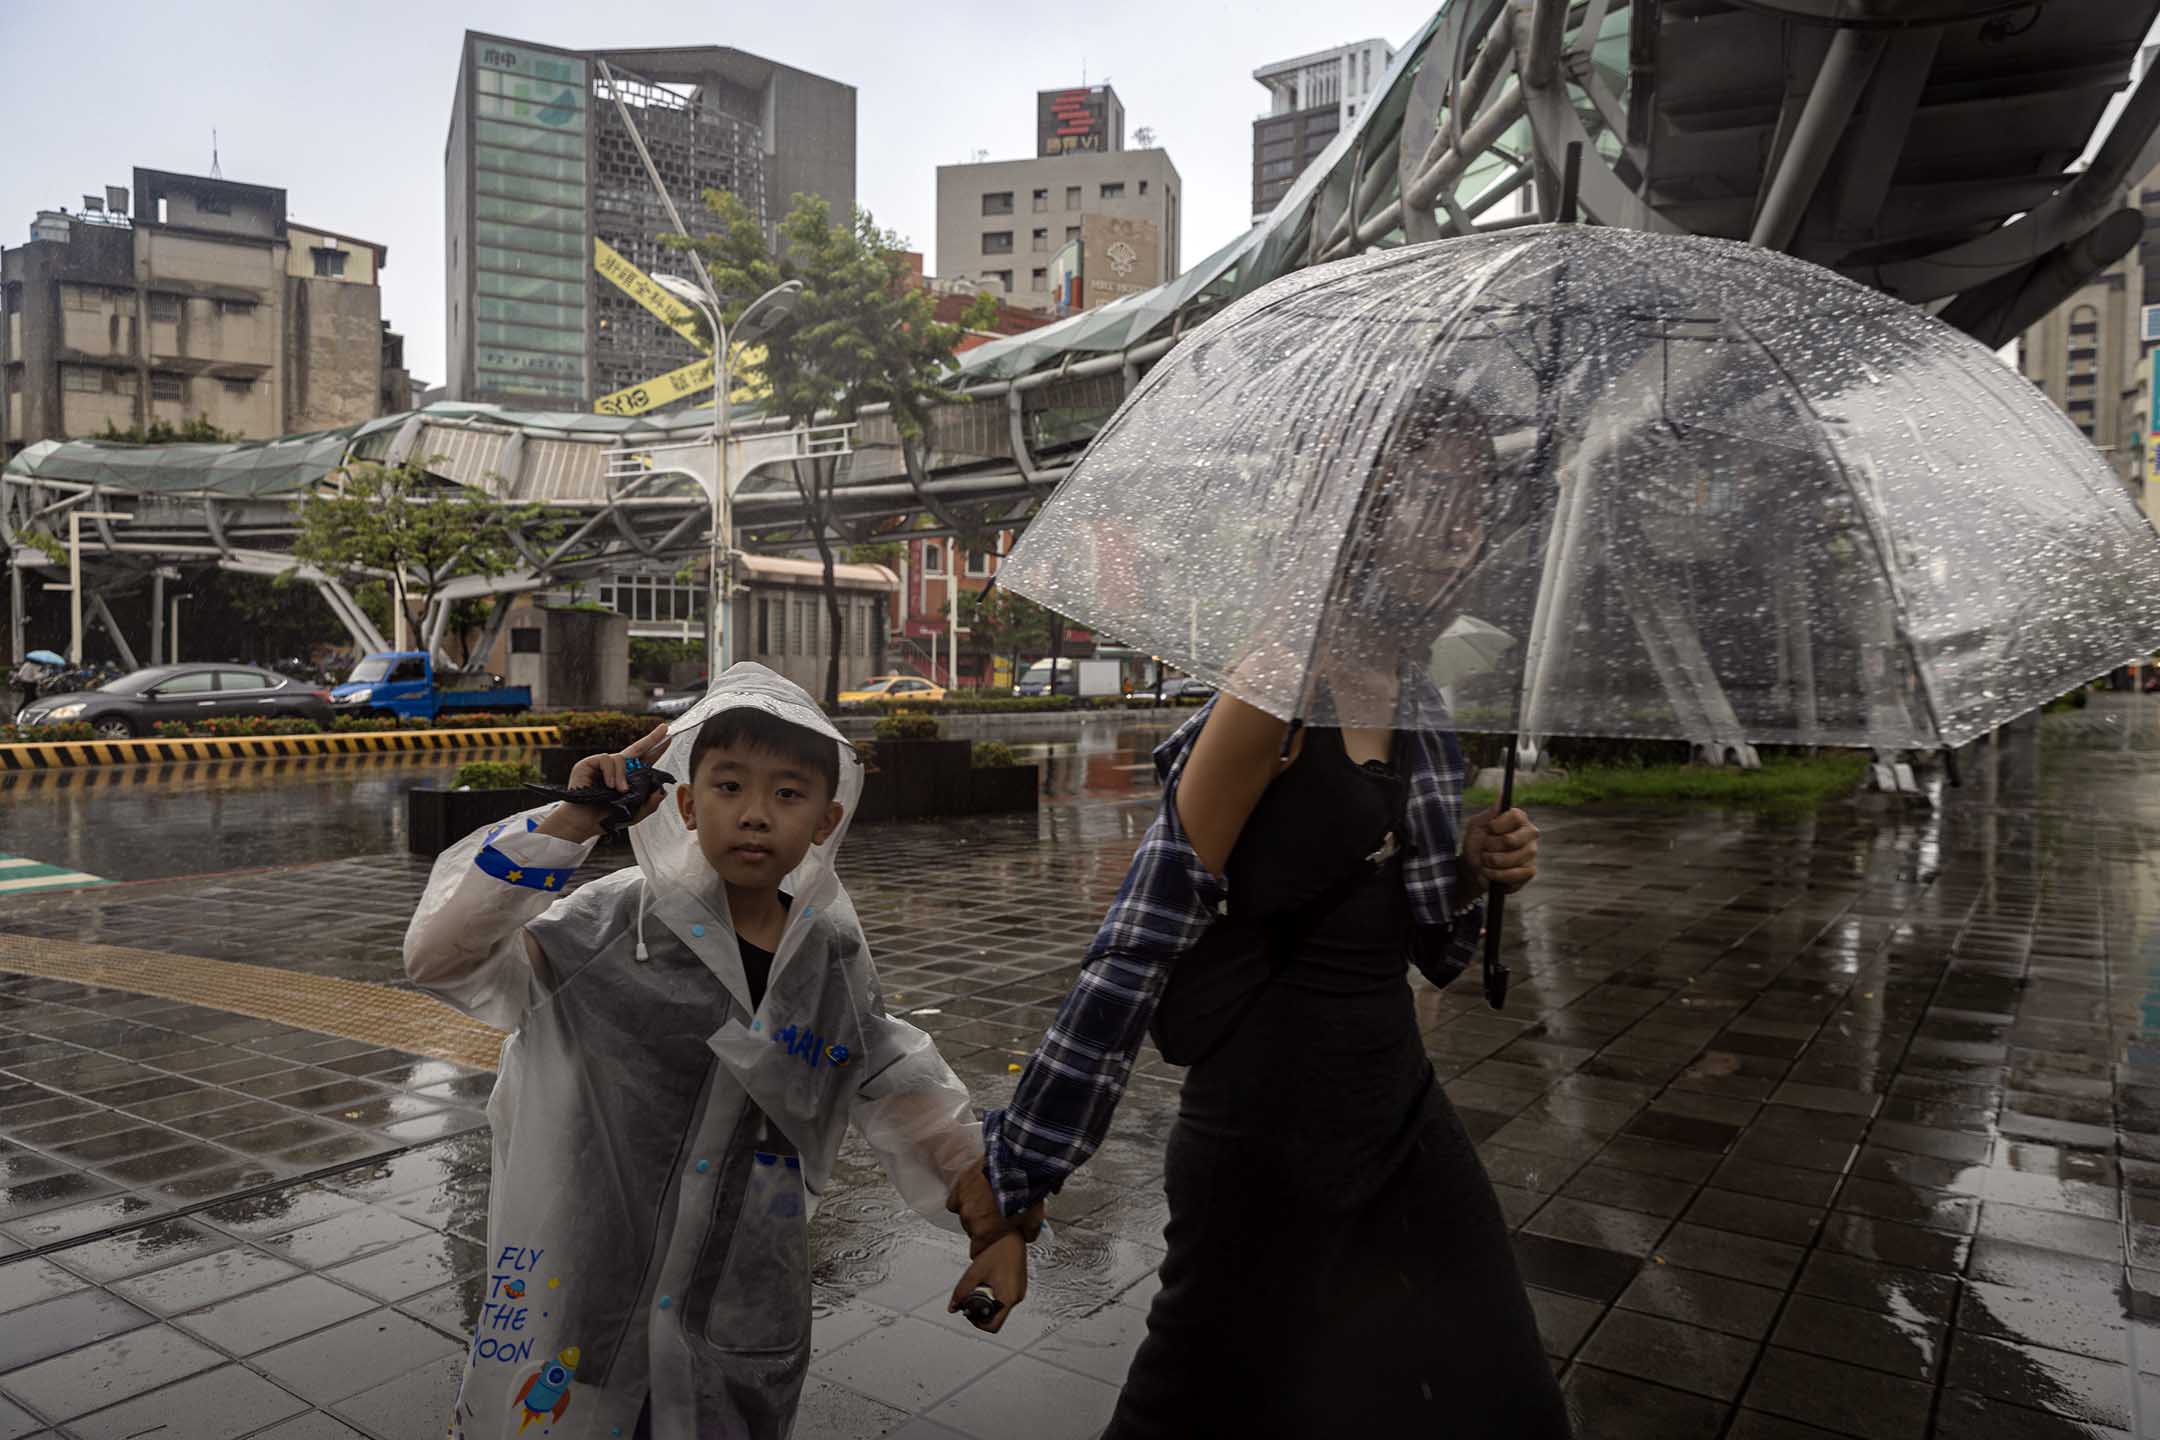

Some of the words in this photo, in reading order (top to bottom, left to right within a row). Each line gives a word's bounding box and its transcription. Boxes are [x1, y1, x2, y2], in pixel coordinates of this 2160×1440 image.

[496, 1246, 544, 1272] FLY
[491, 1275, 525, 1299] TO
[483, 1303, 528, 1331] THE
